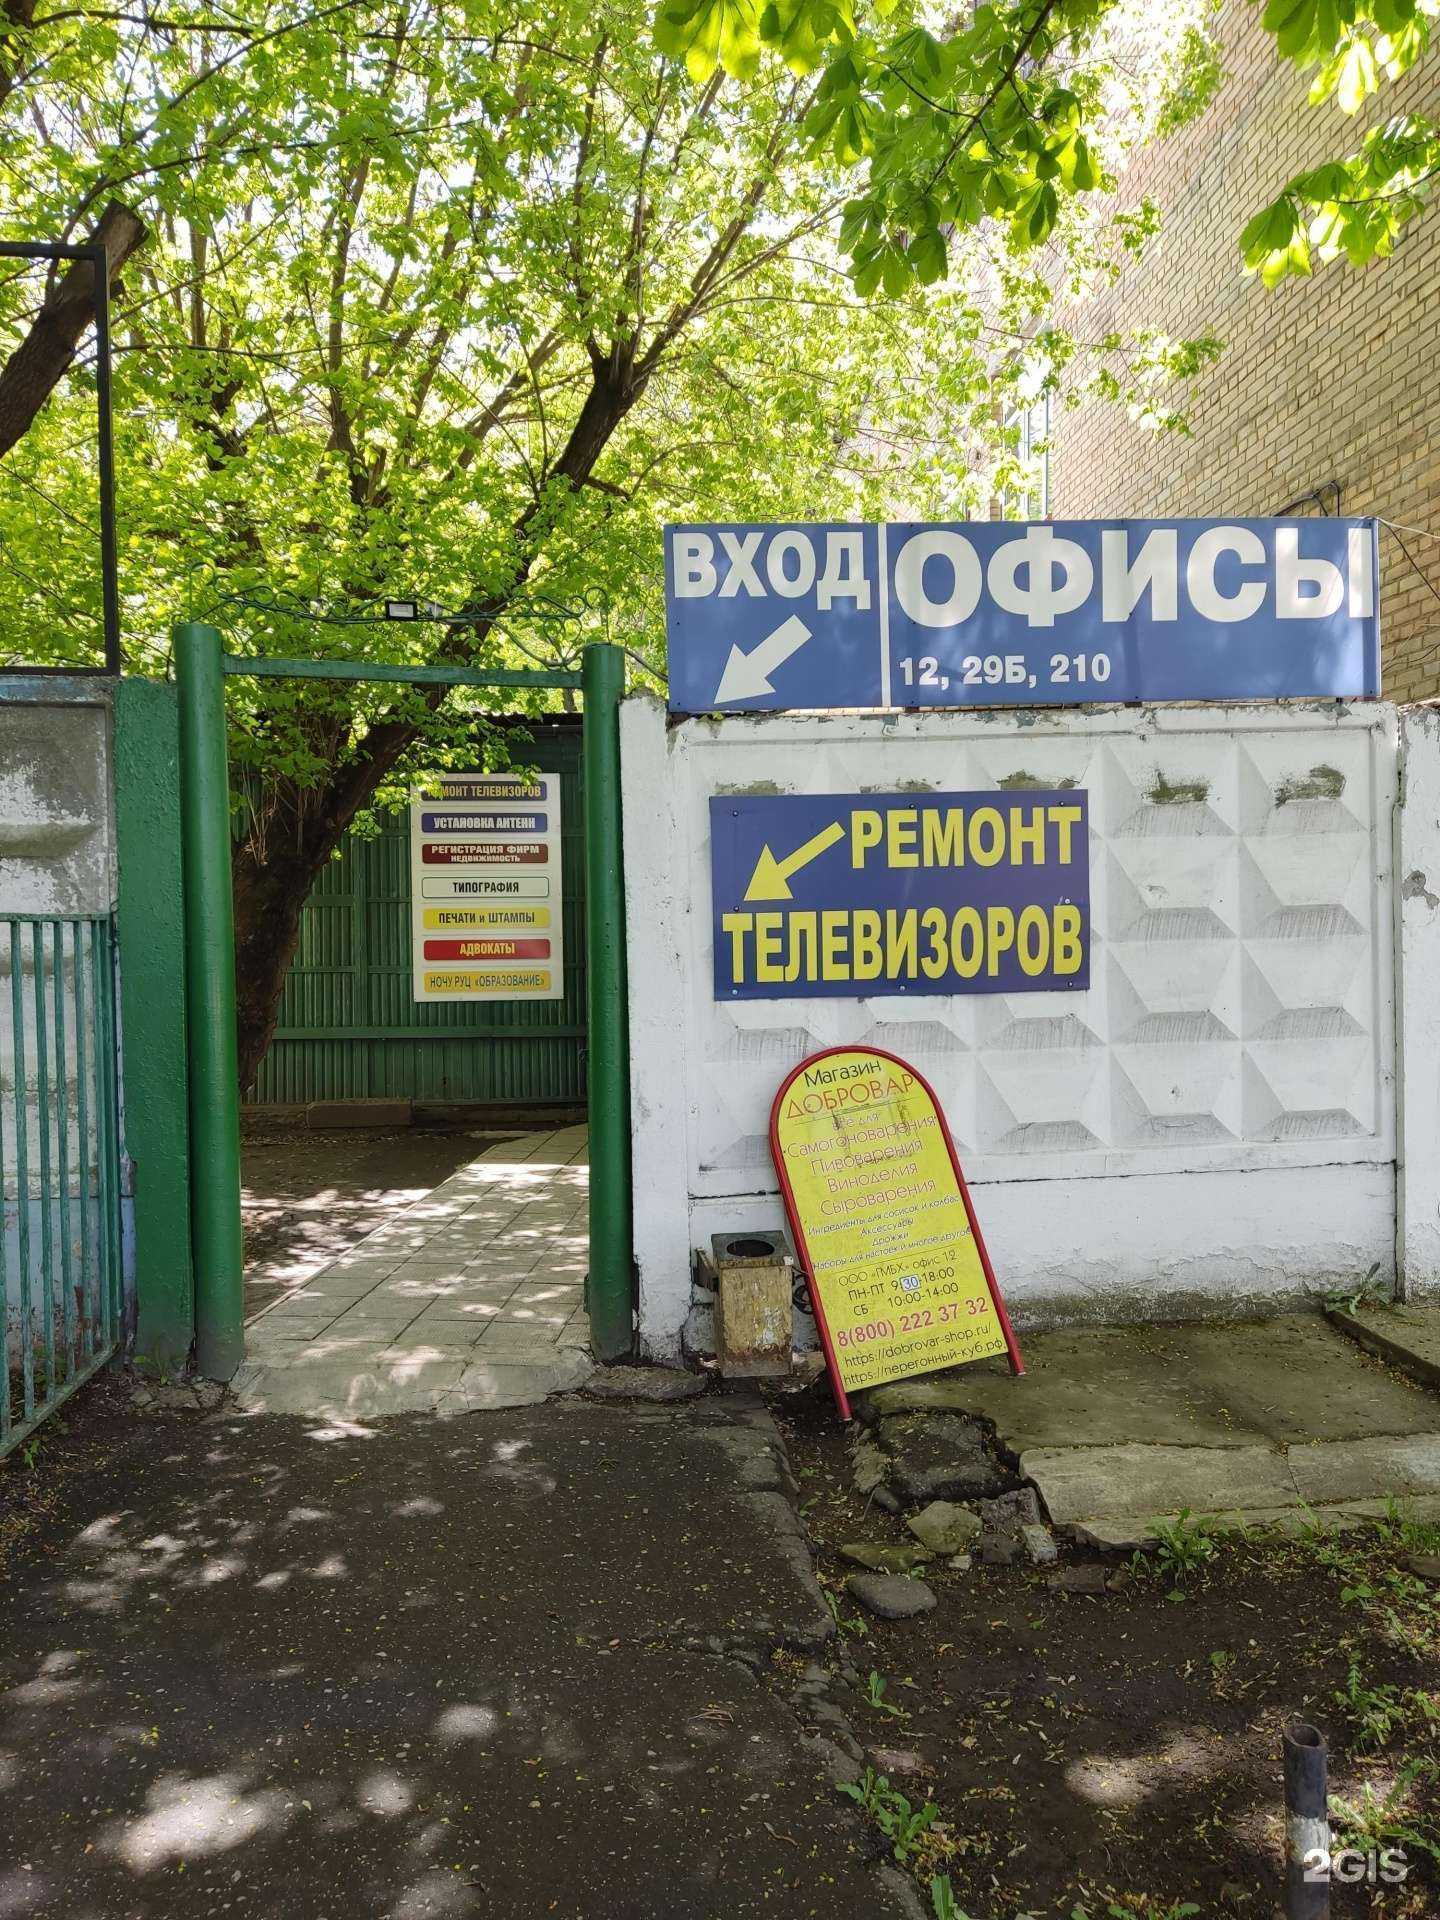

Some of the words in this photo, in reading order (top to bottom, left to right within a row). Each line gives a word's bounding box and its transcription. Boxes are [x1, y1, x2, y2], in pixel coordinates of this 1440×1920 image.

[672, 531, 871, 610] ВХОД
[894, 525, 1373, 627] ОФИСЫ
[900, 657, 949, 691] 12,
[962, 655, 1036, 689] 29Б,
[1050, 653, 1110, 684] 210
[471, 785, 541, 797] ТЕЛЕВИЗОРОВ
[434, 817, 494, 829] УСТАНОВКА
[496, 817, 536, 829] АНТЕНН
[851, 806, 1082, 869] РЕМОНТ
[432, 845, 503, 855] РЕГИСТРАЦИЯ
[507, 845, 539, 854] ФИРМ
[451, 855, 520, 863] НЕДВИЖИМОСТЬ
[452, 882, 519, 893] ТИПОГРАФИЯ
[439, 913, 475, 923] ПЕЧАТИ
[489, 912, 535, 923] ШТАМПЫ
[460, 943, 515, 956] АДВОКАТЫ
[722, 904, 1083, 985] ТЕЛЕВИЗОРОВ
[430, 976, 452, 988] НОЧУ
[454, 976, 470, 988] РУЦ
[475, 975, 545, 987] «ОБРАЗОВАНИЕ»
[804, 1060, 882, 1087] Магазин
[786, 1073, 914, 1119] ДОБРОВАР
[787, 1116, 935, 1157] Самогоноварения
[811, 1140, 922, 1176] Пивоварения
[828, 1163, 918, 1193] Виноделия
[821, 1180, 936, 1215] Сыроварения
[838, 1271, 868, 1287] ООО
[912, 1255, 940, 1271] офис
[942, 1250, 957, 1262] 12
[848, 1283, 885, 1301] ПН-ПТ
[853, 1304, 869, 1317] СБ
[888, 1282, 959, 1308] 10:00-14:00
[837, 1319, 895, 1348] 8(800)
[900, 1310, 934, 1332] 222
[938, 1303, 958, 1321] 37
[966, 1297, 989, 1314] 32
